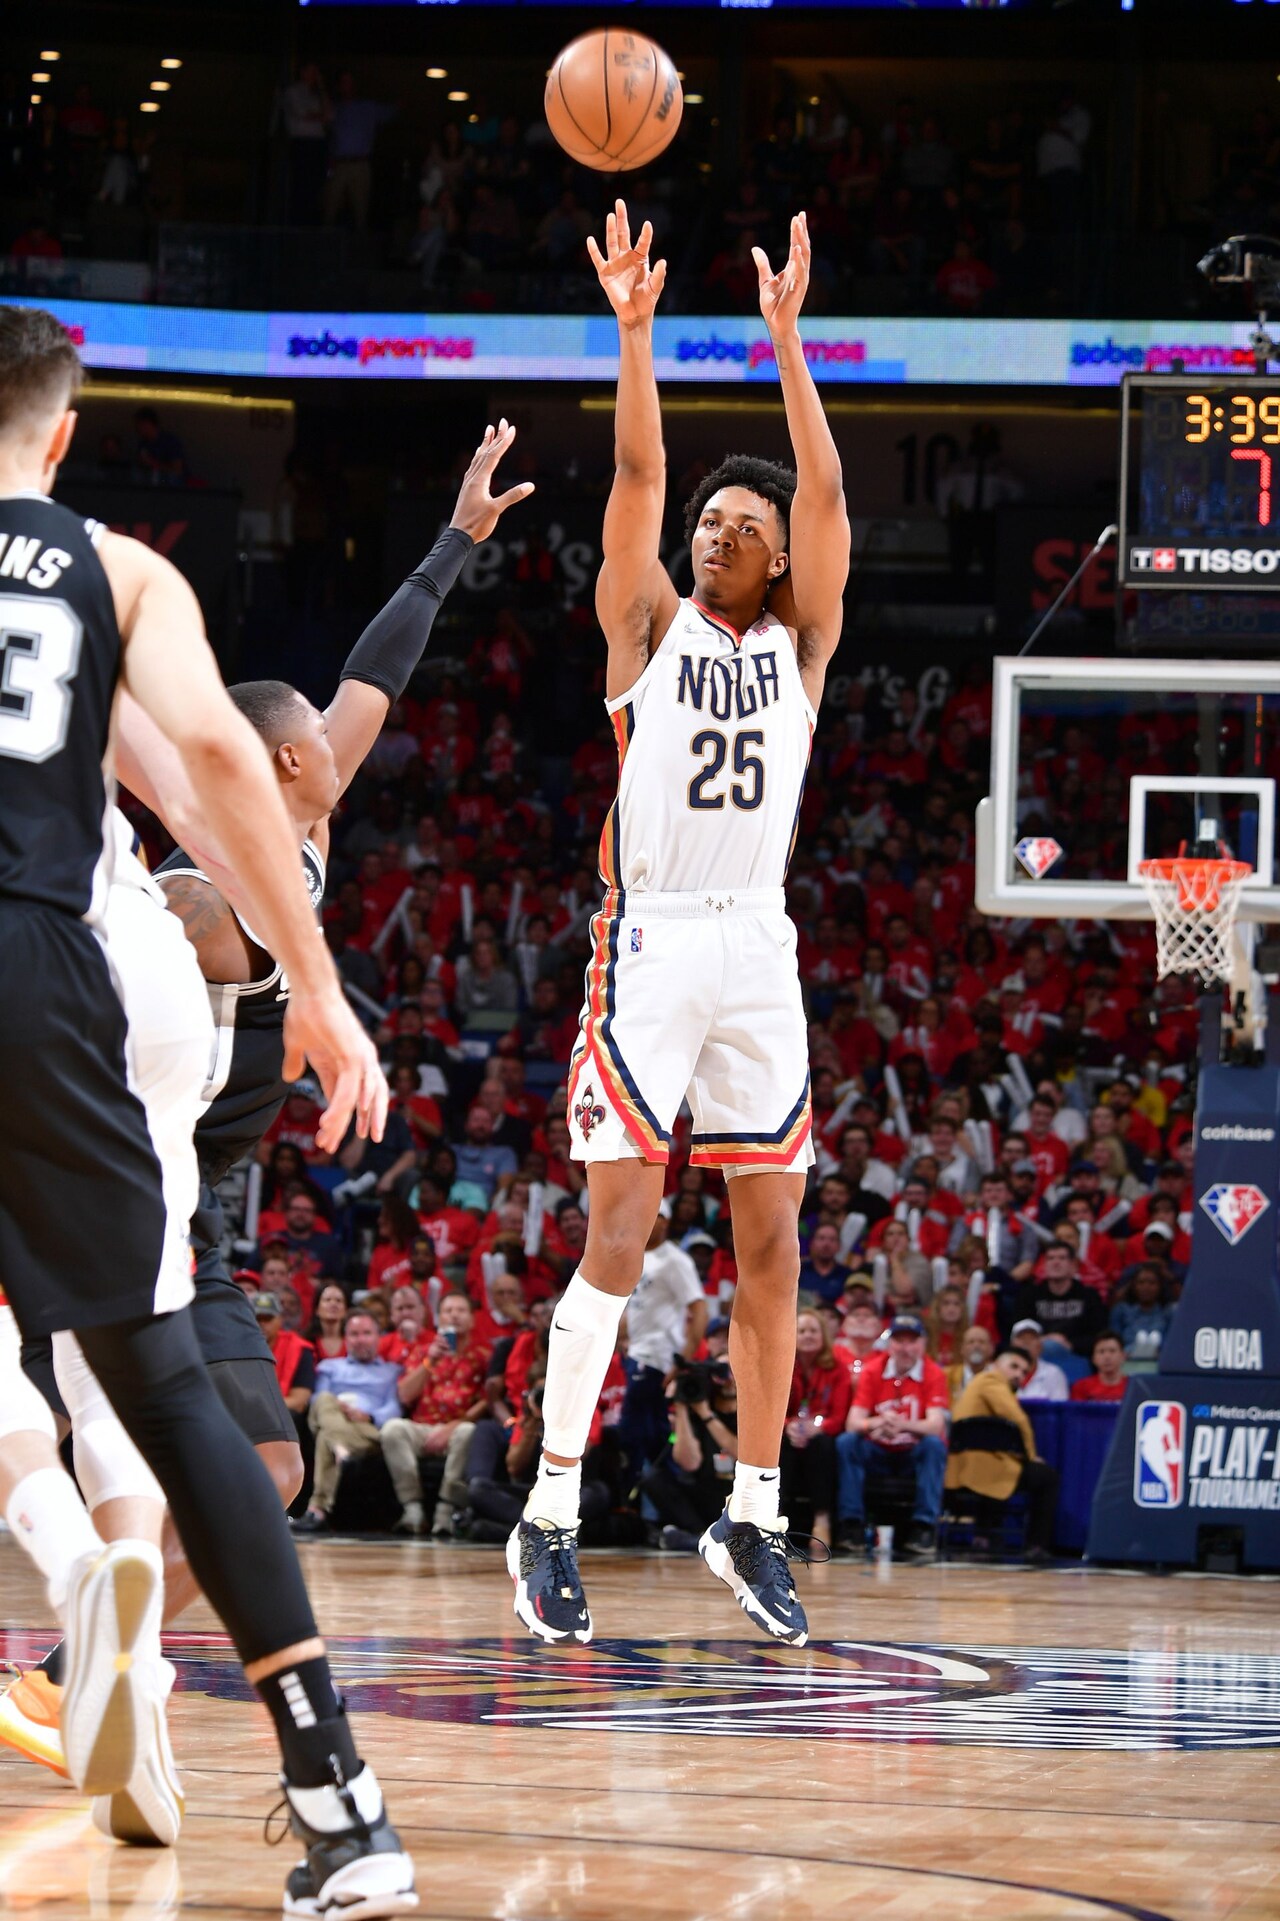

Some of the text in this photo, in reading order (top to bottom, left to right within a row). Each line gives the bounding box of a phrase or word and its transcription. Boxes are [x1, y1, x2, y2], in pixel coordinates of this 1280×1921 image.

[1185, 395, 1280, 443] 3:39
[1230, 449, 1272, 526] 7
[676, 651, 780, 722] NOLA
[686, 728, 765, 812] 25
[1201, 1124, 1275, 1142] coinbase
[1194, 1327, 1263, 1371] @NBA
[1211, 1405, 1246, 1420] Meta
